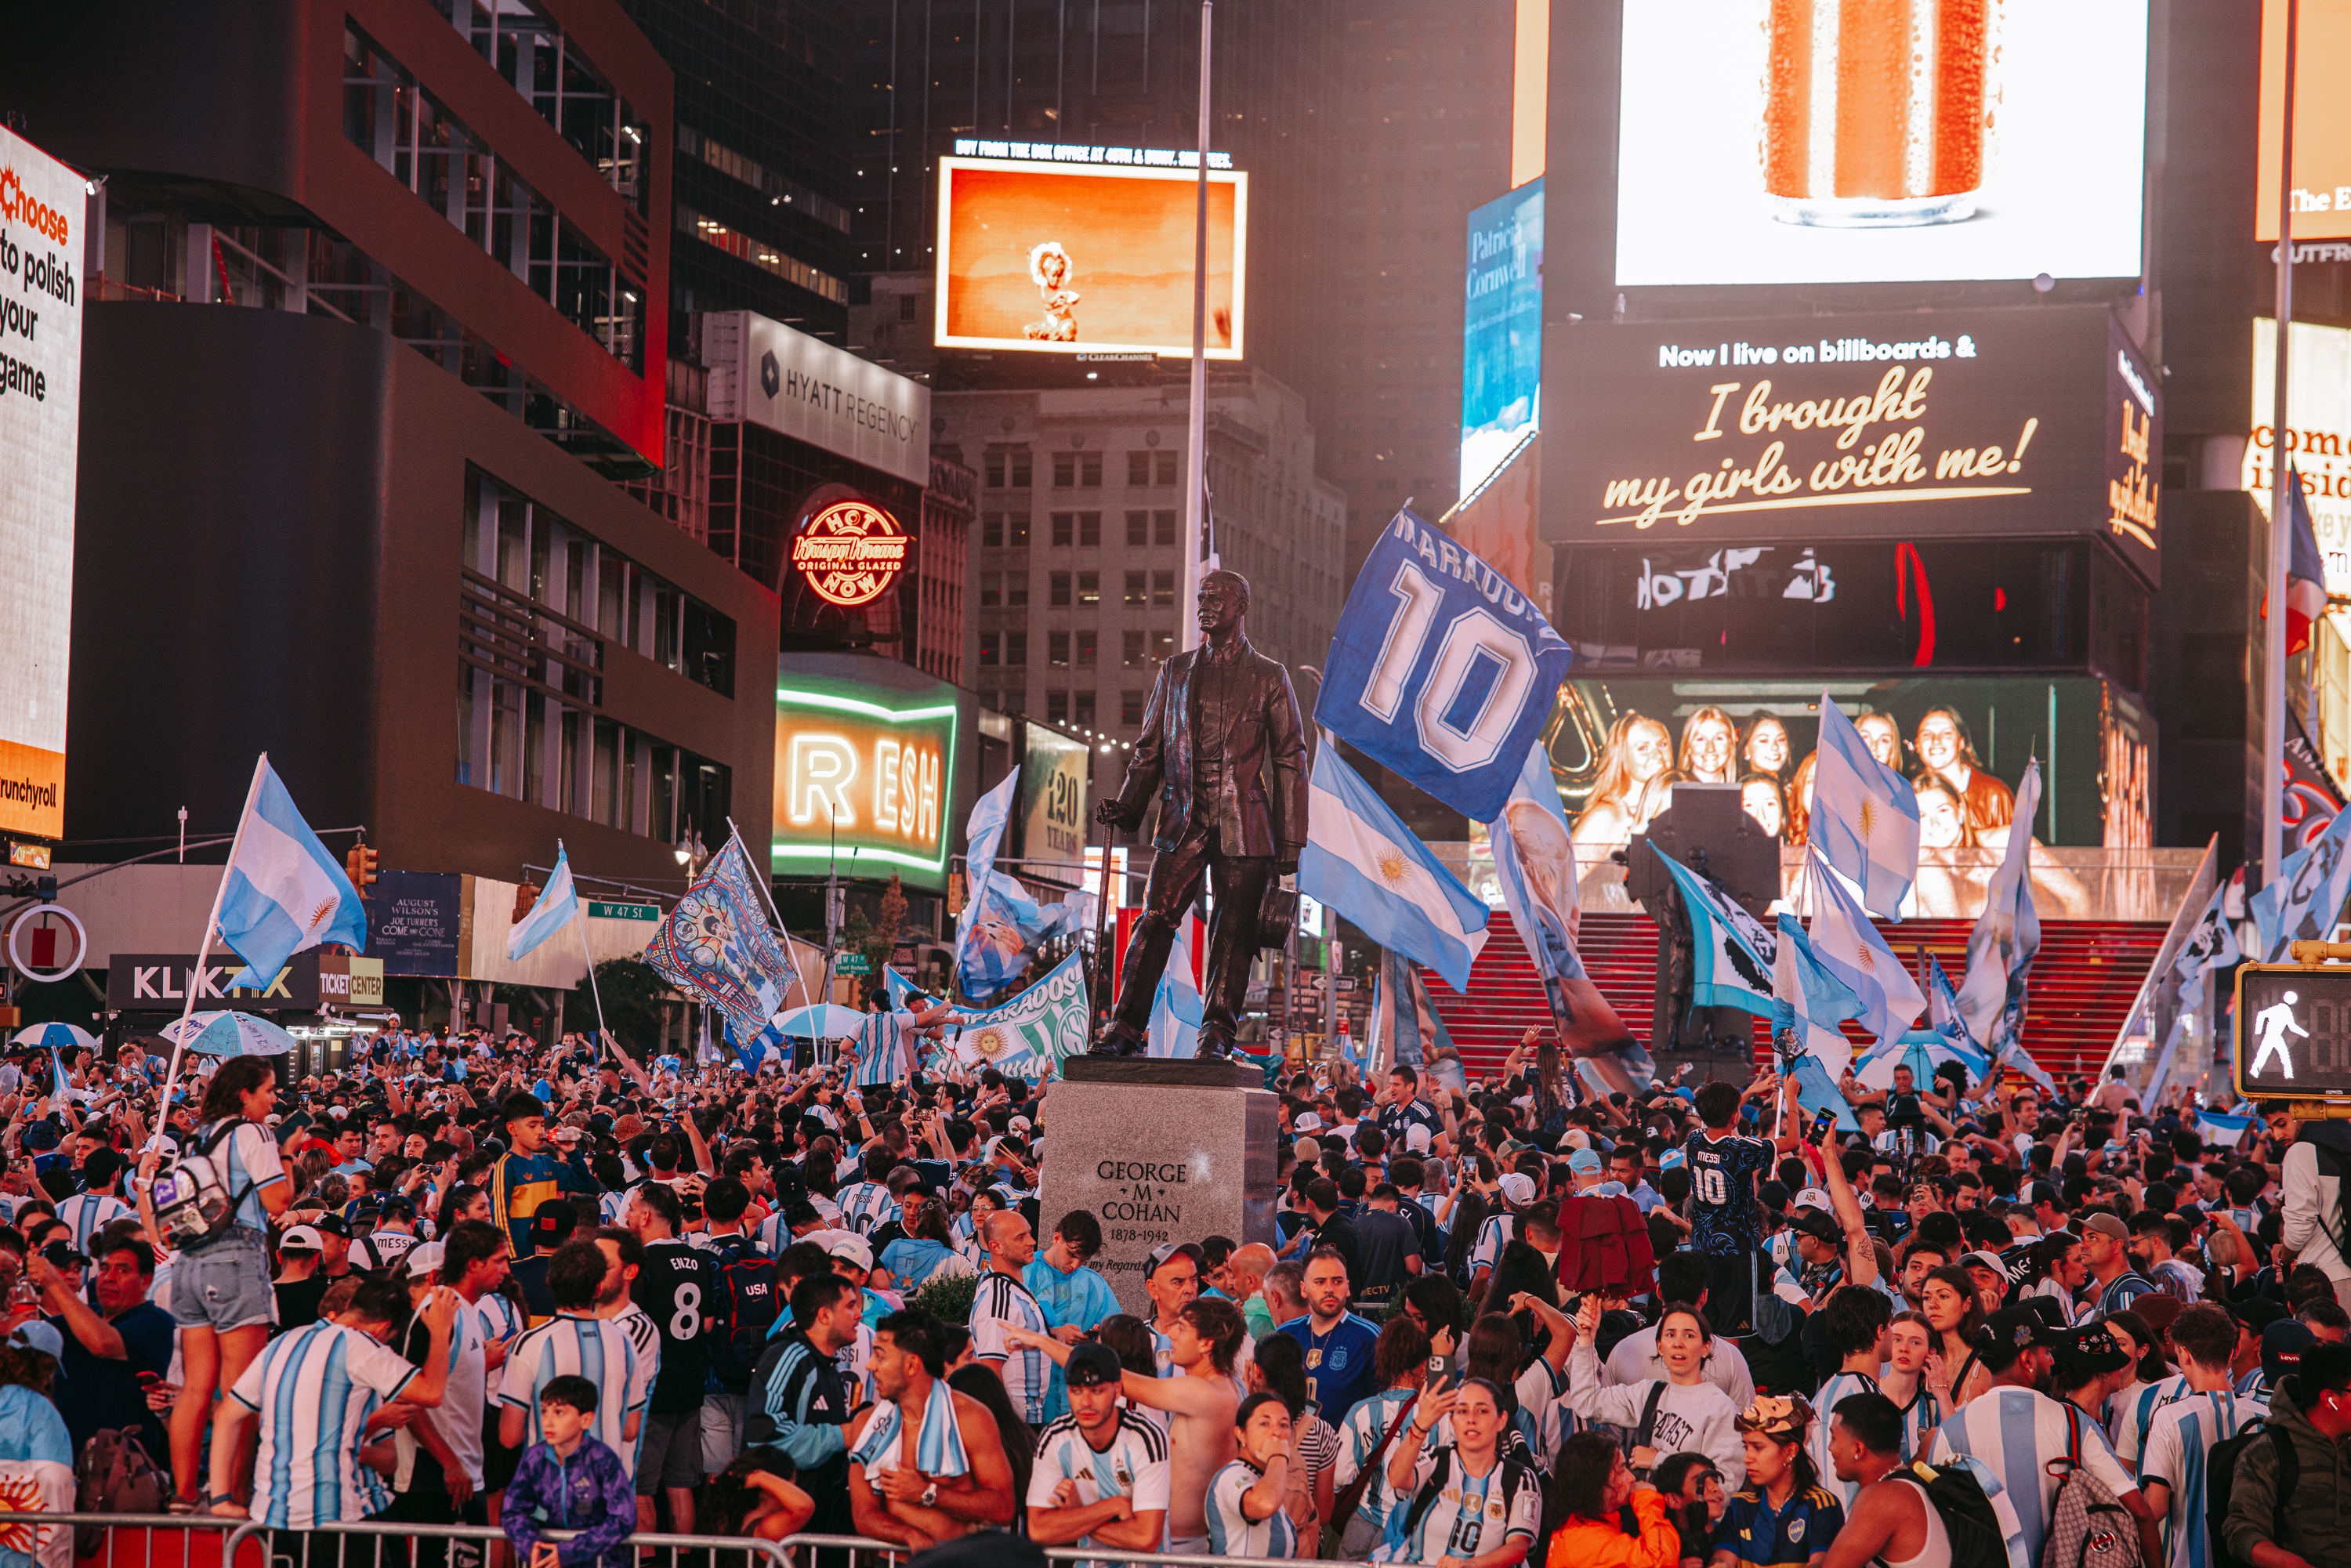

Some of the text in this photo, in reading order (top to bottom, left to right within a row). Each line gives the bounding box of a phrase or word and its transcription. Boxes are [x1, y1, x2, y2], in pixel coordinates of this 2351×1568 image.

[1179, 150, 1200, 167] SAV
[0, 160, 68, 246] Choose
[0, 228, 19, 275] to
[1471, 216, 1522, 264] Patricia
[2270, 241, 2351, 265] UTFR
[24, 251, 75, 306] polish
[1466, 244, 1526, 300] Cornwell
[1659, 335, 1976, 368] Now I live on billboards &
[787, 368, 919, 444] HYATT REGENCY
[1694, 364, 1933, 450] I brought
[2252, 425, 2351, 457] com
[1603, 417, 2039, 530] my girls with me!
[825, 509, 876, 531] HOT
[793, 536, 907, 563] Krispy Kreme
[797, 561, 901, 571] ORIGINAL GLAZED
[823, 573, 877, 598] NOW
[1358, 557, 1539, 774] 10
[0, 774, 56, 811] runchyroll
[1047, 770, 1078, 828] 120
[1046, 824, 1078, 853] YEARS
[391, 907, 439, 916] WILSON'S
[397, 899, 436, 907] AUGUST
[603, 906, 643, 918] W 47 St
[382, 925, 409, 936] COME
[418, 927, 446, 938] GONE
[390, 917, 439, 927] JOE TURNER'S
[320, 972, 382, 996] TICKET CENTER
[1337, 980, 1352, 989] WAY
[1697, 1150, 1720, 1164] MESSI
[1097, 1160, 1186, 1183] GEORGE
[1132, 1183, 1153, 1201] M
[1693, 1164, 1727, 1205] 10
[852, 1193, 874, 1204] MESSI
[1102, 1201, 1181, 1223] COHAN
[1110, 1228, 1168, 1244] 1878-1942
[670, 1257, 698, 1270] ENZO
[1089, 1258, 1146, 1274] my Regards
[745, 1282, 768, 1296] USA
[670, 1282, 701, 1341] 8
[1448, 1515, 1483, 1555] 10
